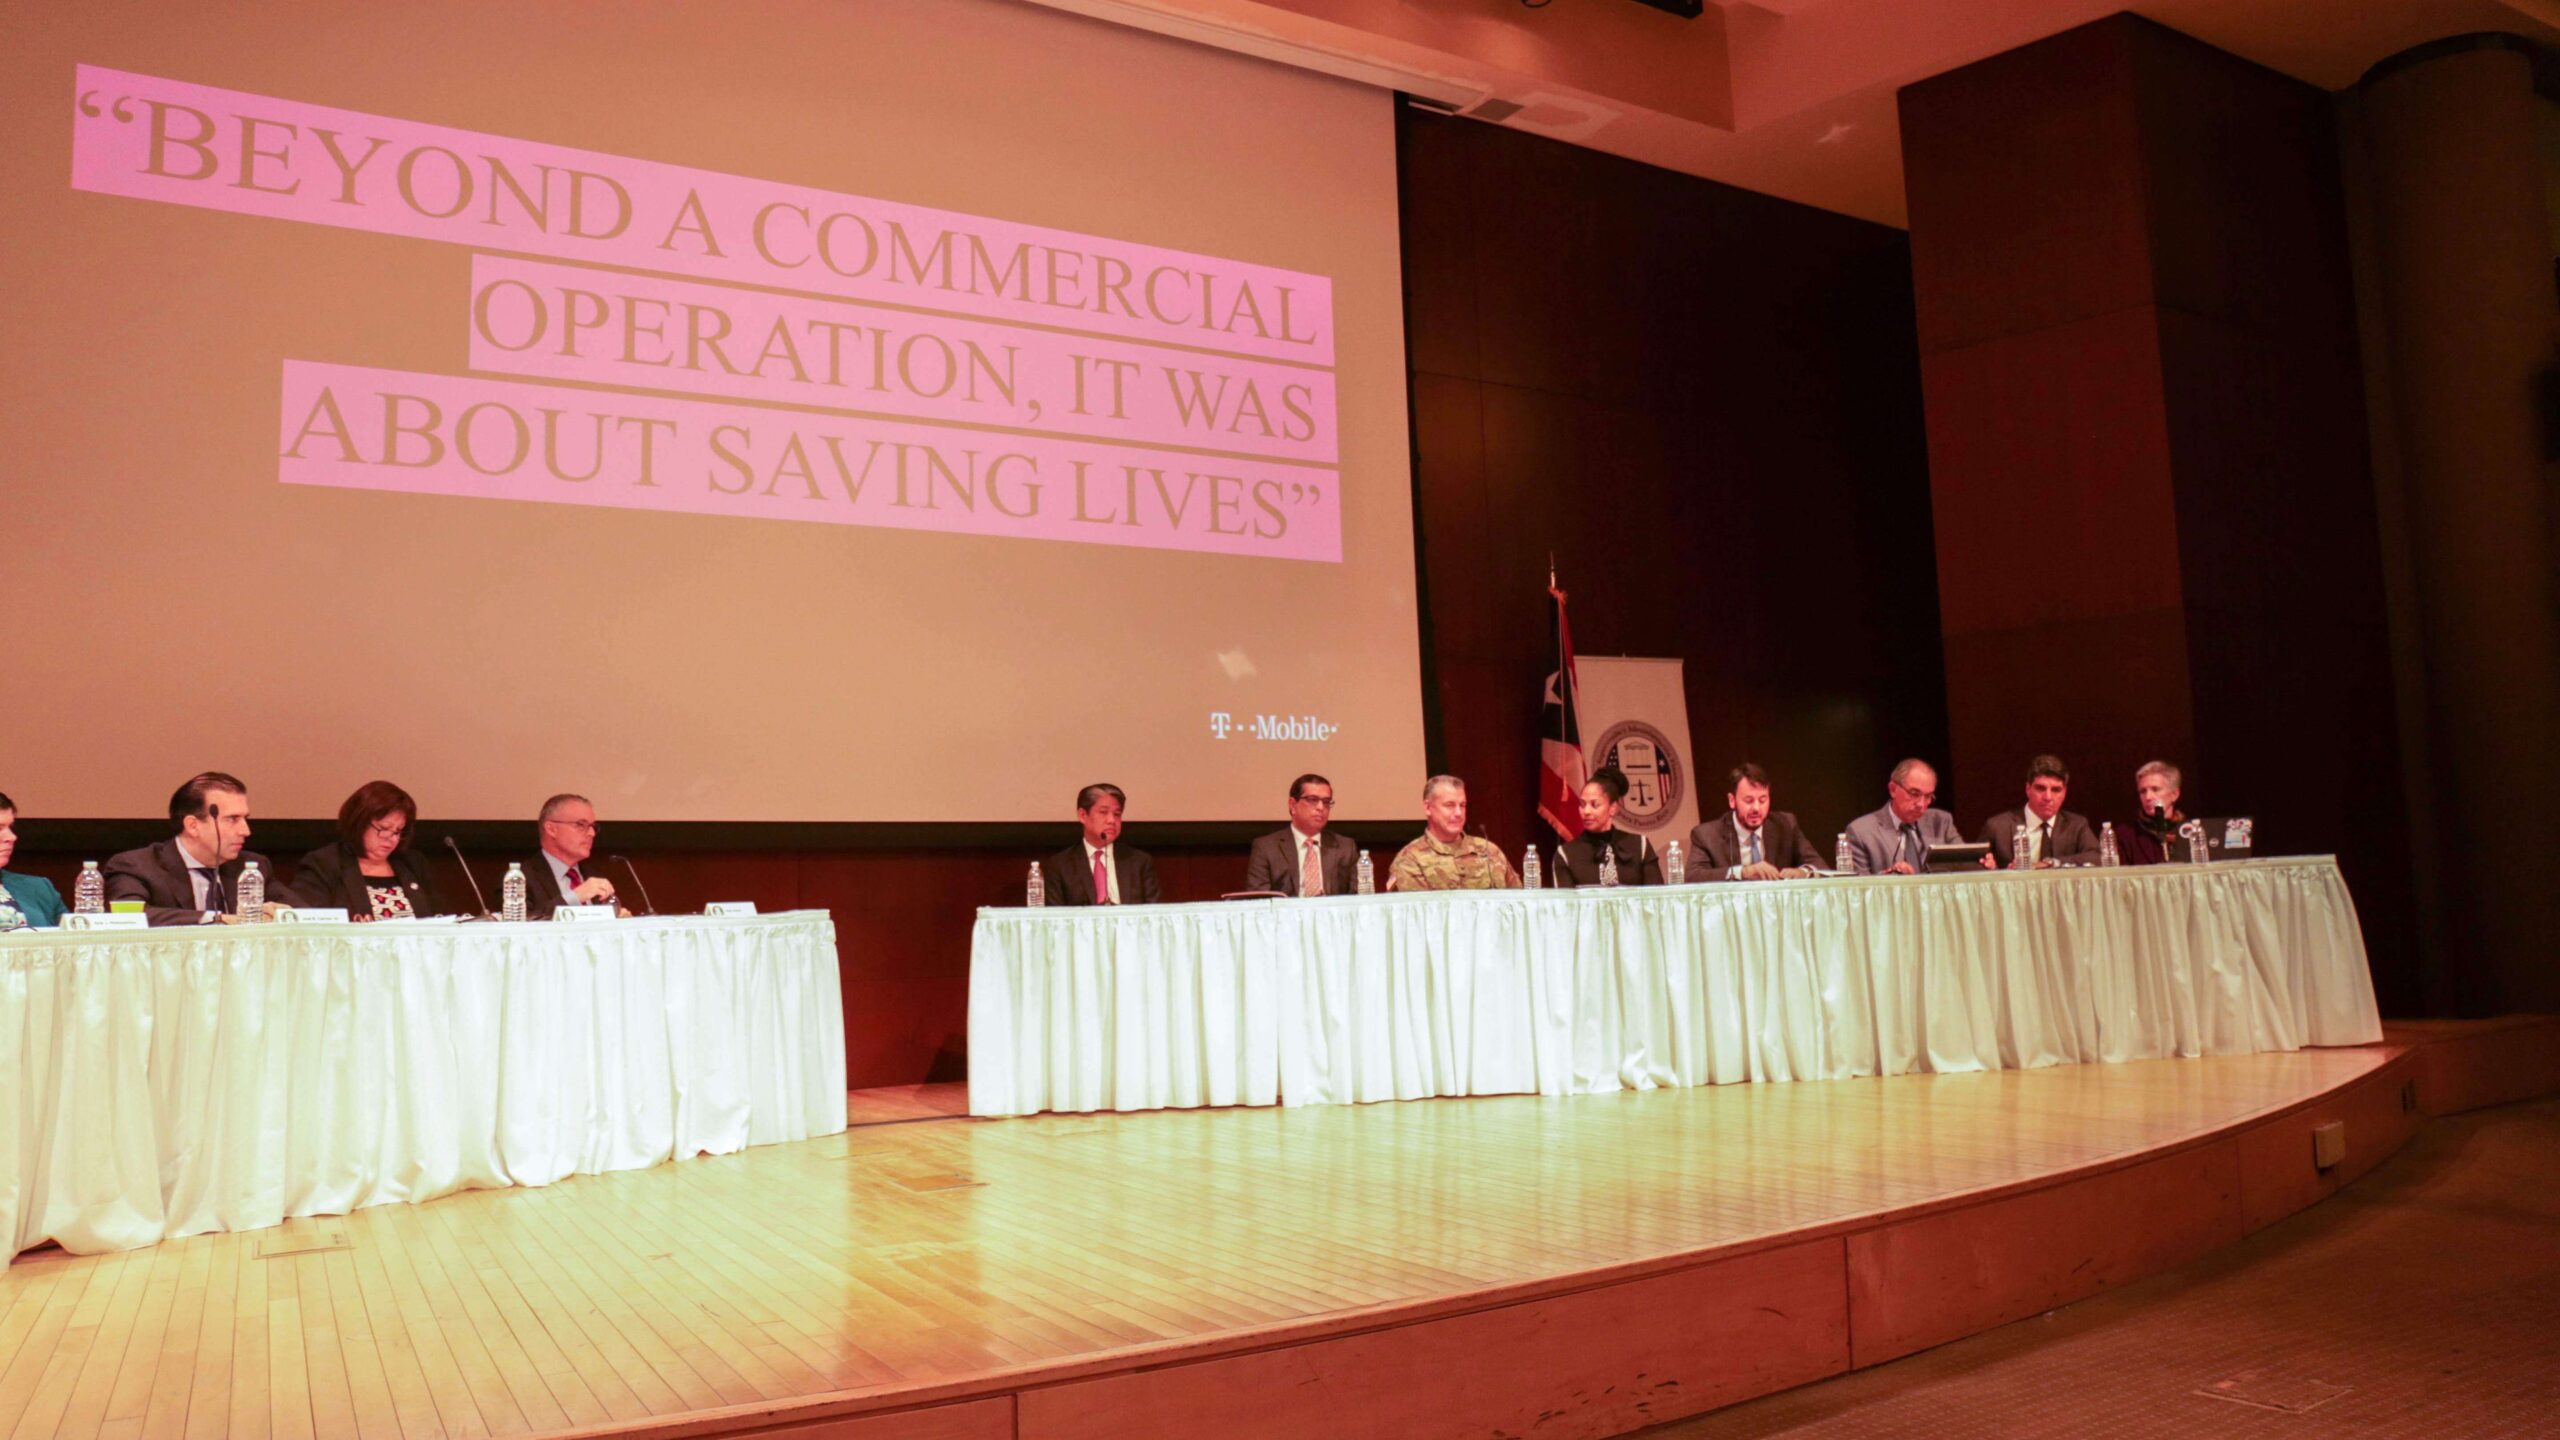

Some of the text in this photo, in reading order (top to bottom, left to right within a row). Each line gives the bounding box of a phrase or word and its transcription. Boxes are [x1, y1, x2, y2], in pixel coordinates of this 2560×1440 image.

[656, 188, 727, 258] A
[752, 202, 1317, 345] COMMERCIAL
[473, 279, 1317, 443] OPERATION, IT WAS
[281, 385, 679, 489] ABOUT
[706, 424, 1045, 520] SAVING
